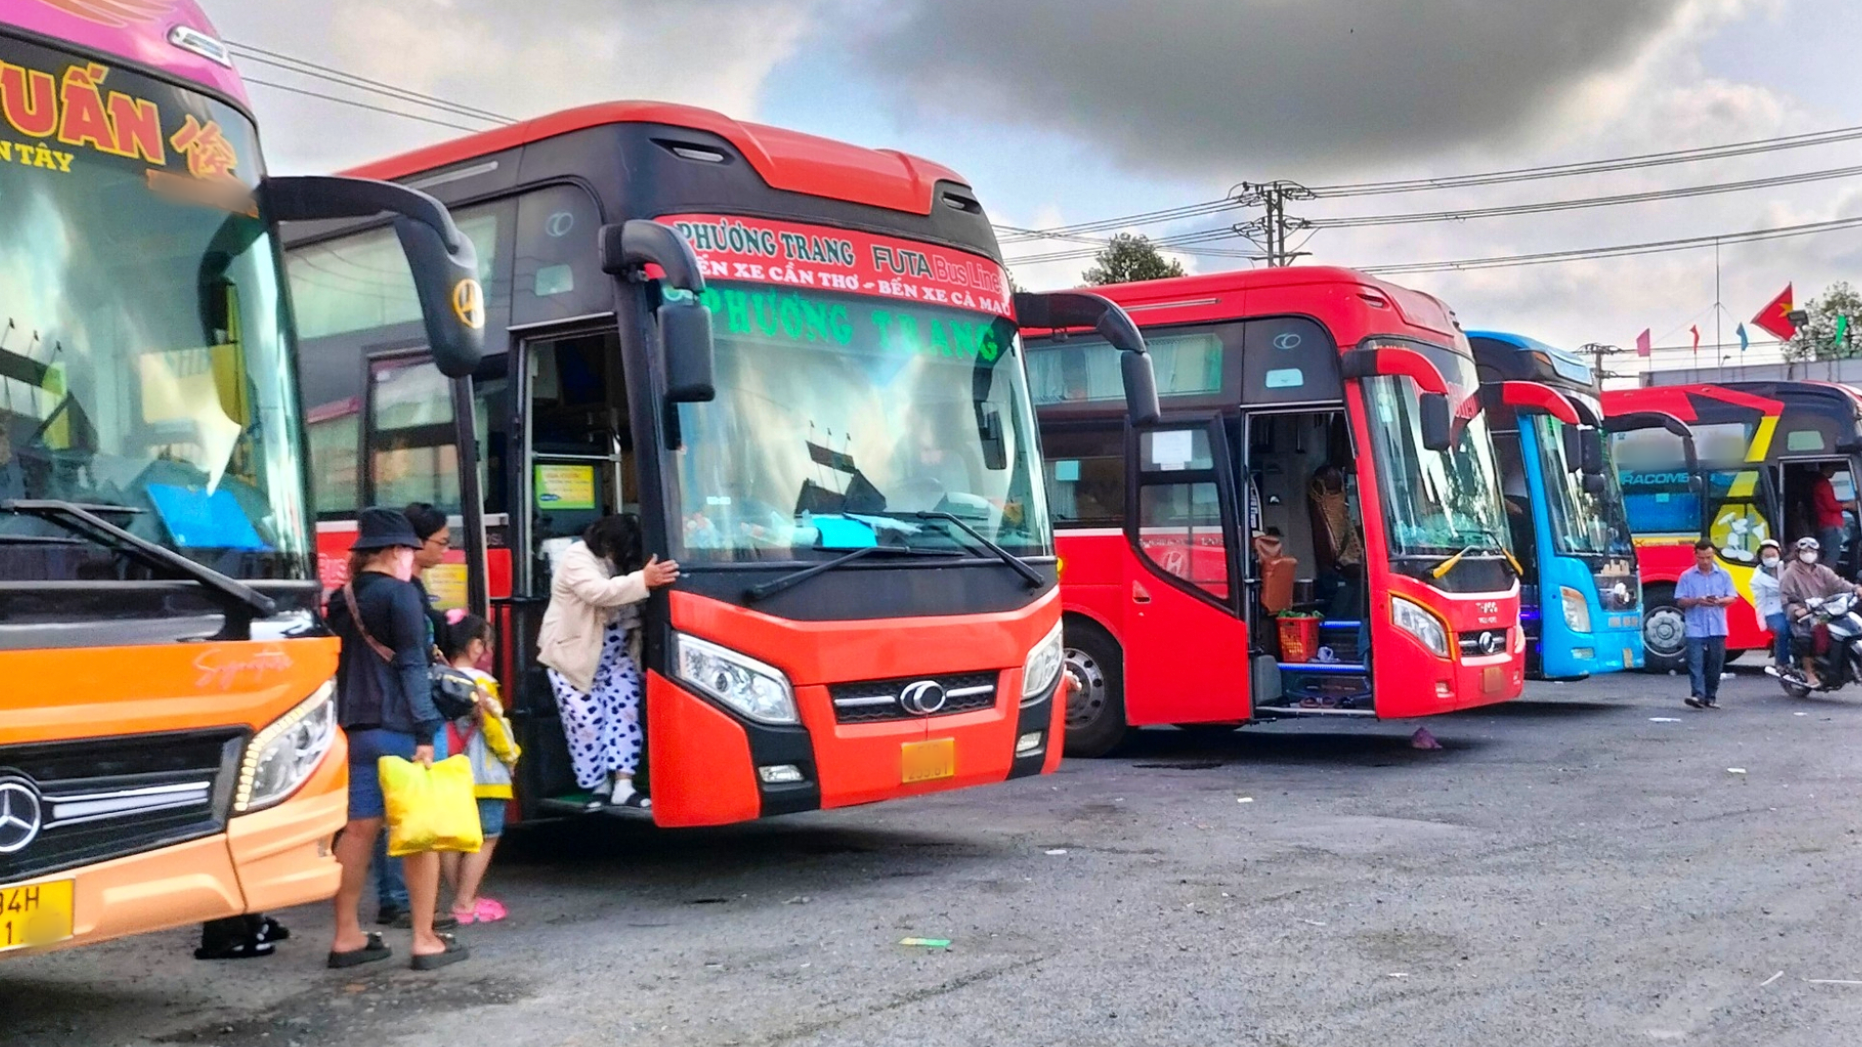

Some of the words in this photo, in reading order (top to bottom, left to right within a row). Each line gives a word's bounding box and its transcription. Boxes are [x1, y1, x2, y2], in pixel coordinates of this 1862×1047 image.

[14, 142, 75, 172] TÂY
[675, 219, 777, 257] PHƯƠNG
[780, 231, 855, 266] TRANG
[696, 253, 729, 276] ẾN
[733, 262, 765, 280] XE
[768, 261, 814, 285] CẦN
[817, 271, 860, 291] THƠ
[876, 276, 919, 299] BẾN
[920, 285, 949, 304] XE
[951, 290, 977, 309] CÀ
[977, 295, 1012, 317] MAU
[870, 244, 934, 280] FUTA
[965, 261, 1003, 296] Line
[871, 309, 999, 363] TRANG
